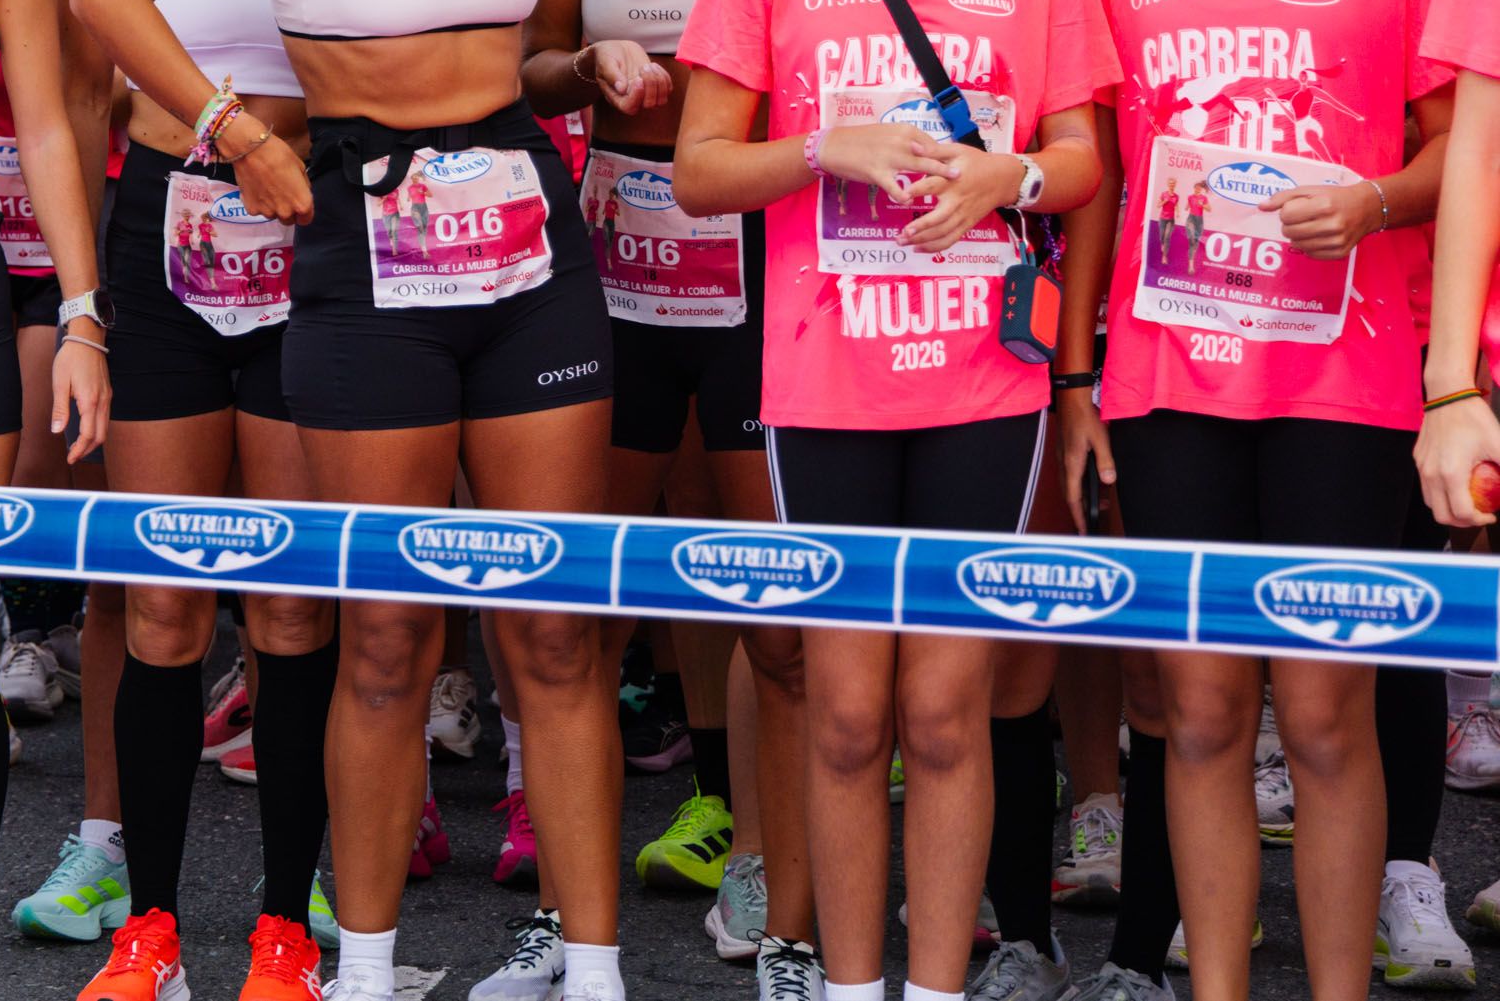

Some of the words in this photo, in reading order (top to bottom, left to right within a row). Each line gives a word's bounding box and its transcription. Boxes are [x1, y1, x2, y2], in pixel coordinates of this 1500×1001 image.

[628, 9, 682, 22] OYSHO
[1142, 26, 1317, 89] CARRERA
[837, 105, 874, 116] SUMA
[1168, 156, 1203, 172] SUMA
[435, 207, 503, 242] 016
[838, 228, 883, 238] CARRERA
[886, 229, 898, 238] DE
[221, 249, 285, 275] 016
[466, 245, 482, 258] 13
[618, 234, 680, 266] 016
[842, 249, 907, 263] OYSHO
[1205, 232, 1283, 271] 016
[393, 263, 436, 275] CARRERA
[438, 263, 450, 273] DE
[452, 262, 465, 273] LA
[467, 258, 498, 272] MUJER
[397, 282, 458, 297] OYSHO
[620, 280, 629, 289] DE
[631, 281, 641, 291] LA
[643, 284, 671, 295] MUJER
[679, 286, 685, 295] A
[687, 284, 725, 296] CORUÑA
[1225, 272, 1253, 288] 868
[185, 293, 222, 305] CARRERA
[281, 291, 288, 300] A
[1158, 276, 1197, 292] CARRERA
[1199, 284, 1211, 296] DE
[1214, 286, 1225, 298] LA
[1229, 289, 1263, 305] MUJER
[1271, 297, 1279, 306] A
[1282, 298, 1323, 311] CORUÑA
[670, 306, 725, 317] Santander
[841, 277, 989, 338] MUJER
[1159, 298, 1219, 319] OYSHO
[1256, 319, 1316, 331] Santander
[892, 340, 946, 371] 2026
[1190, 333, 1244, 364] 2026
[538, 360, 599, 385] OYSHO
[150, 512, 282, 547] ASTURIANA
[412, 528, 549, 564] ASTURIANA
[687, 544, 829, 582] ASTURIANA
[972, 562, 1122, 601] ASTURIANA
[1269, 579, 1426, 621] ASTURIANA
